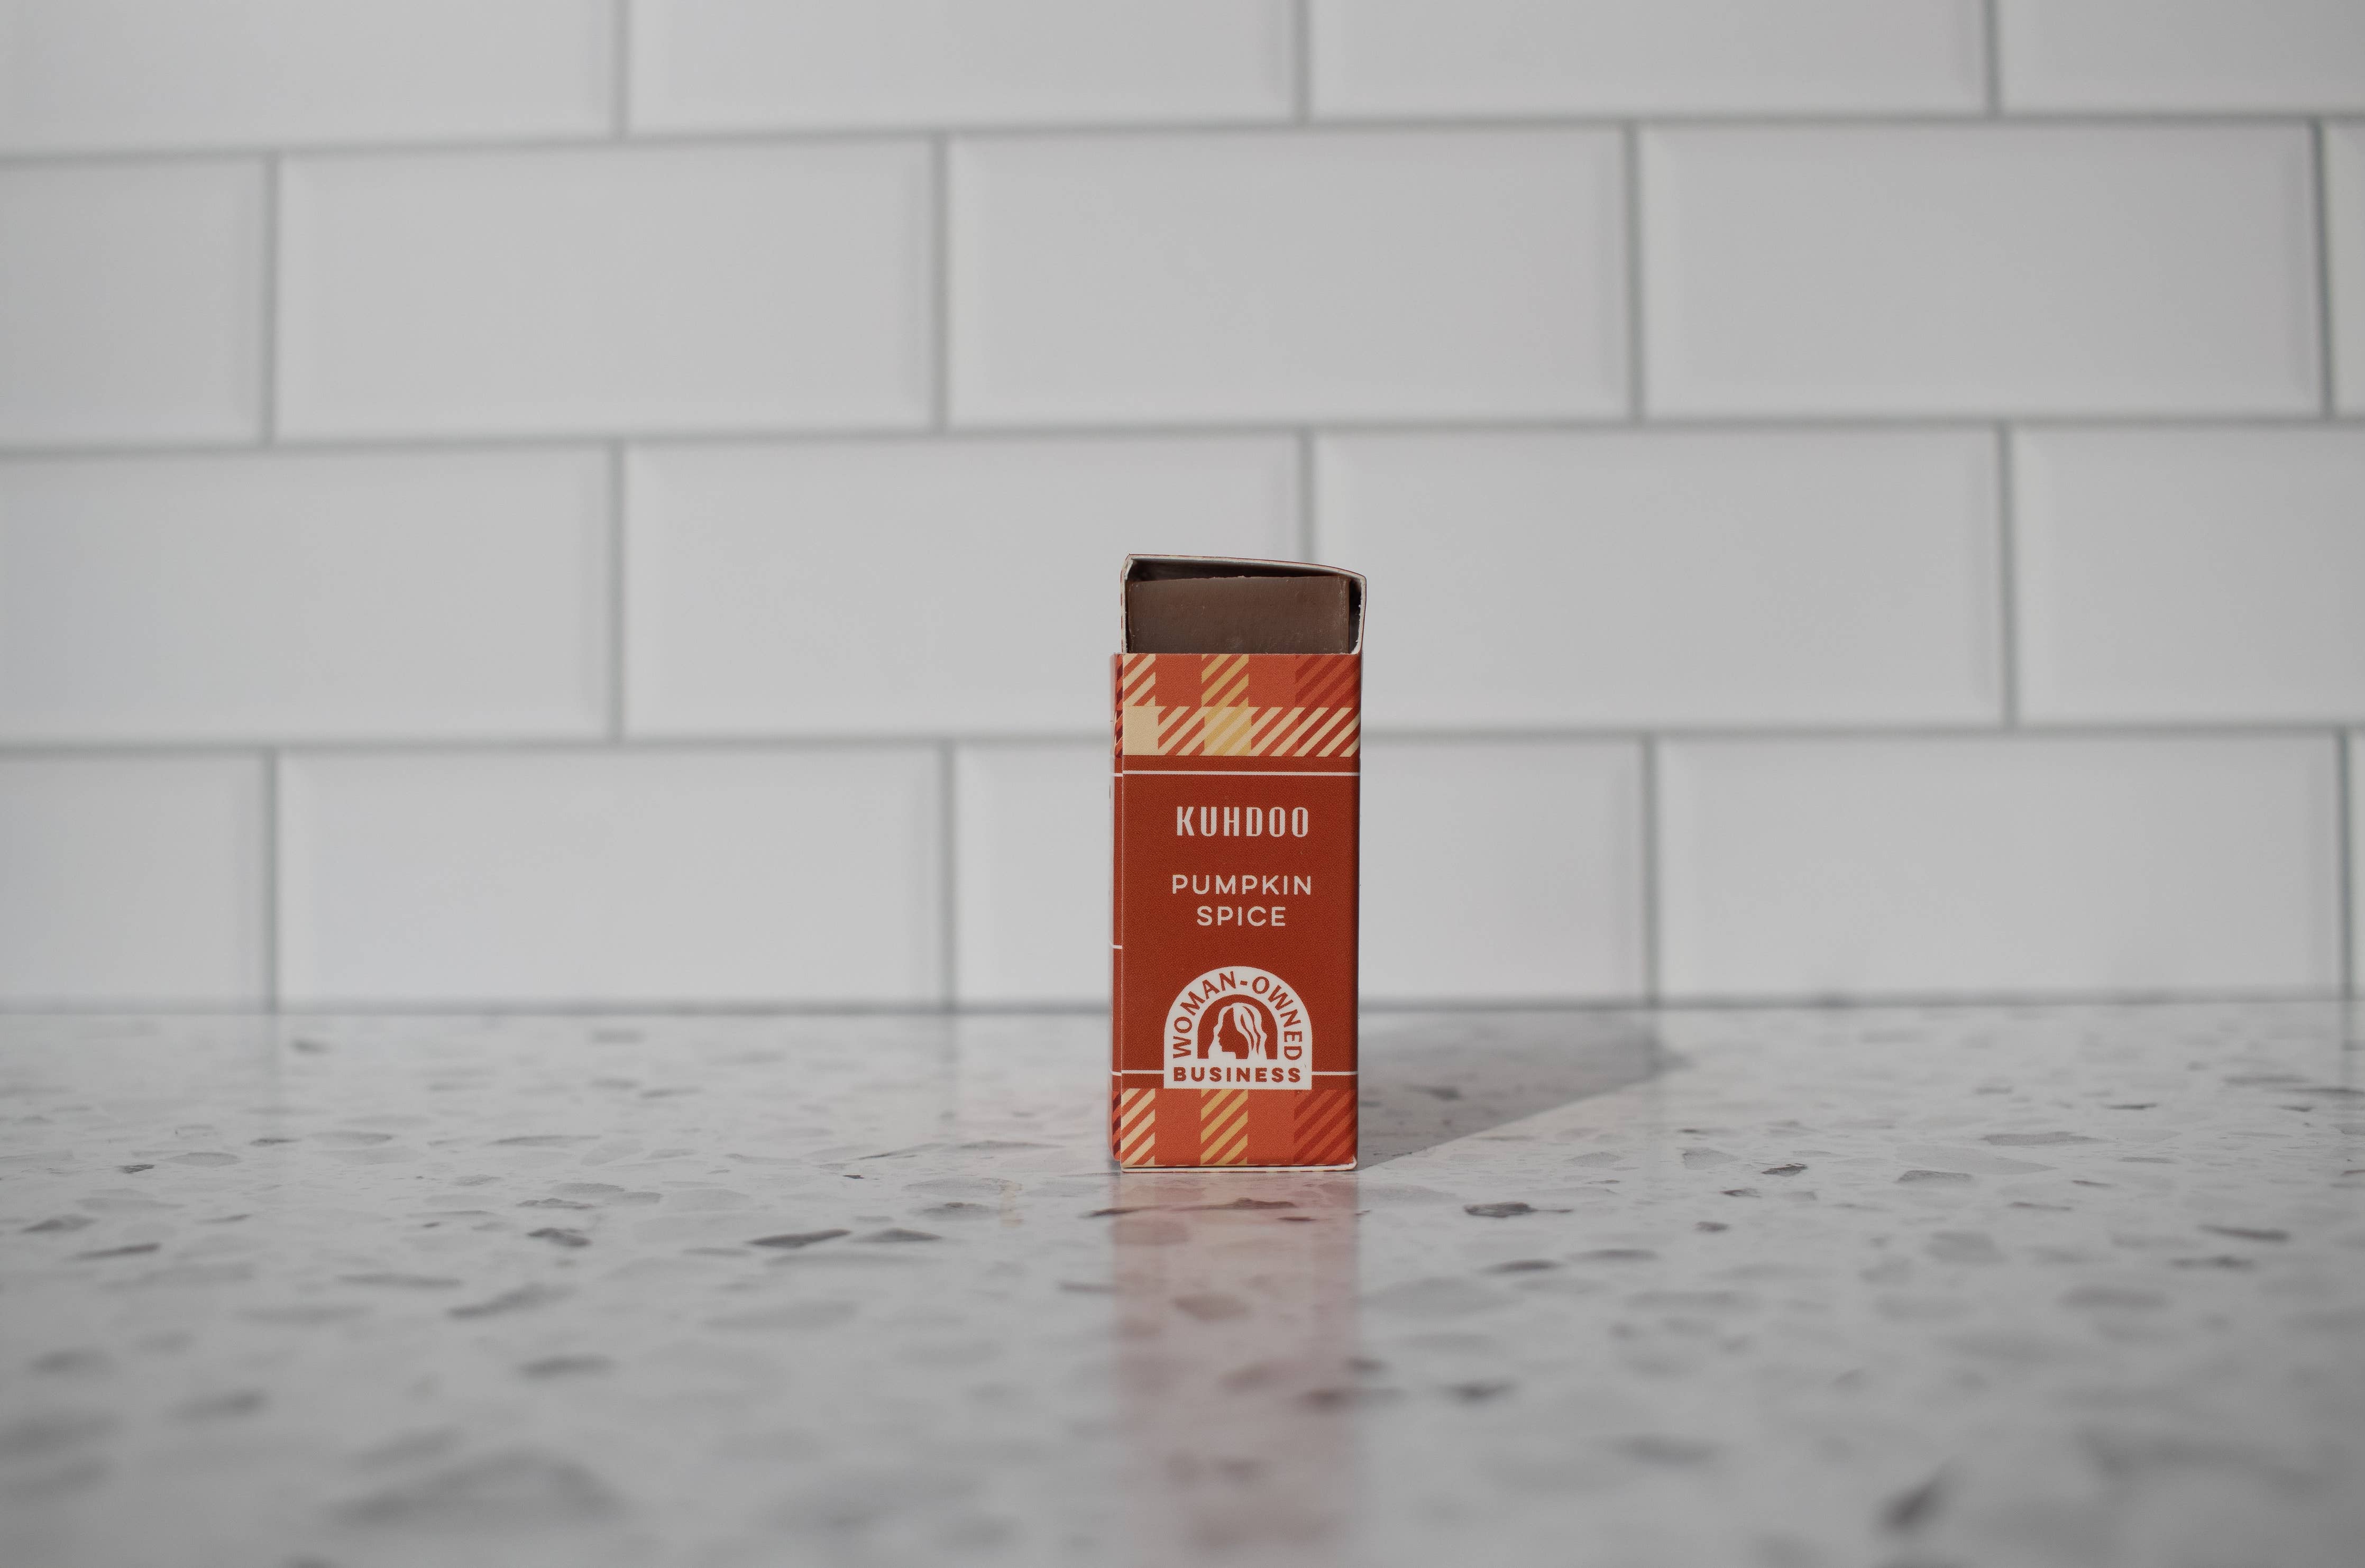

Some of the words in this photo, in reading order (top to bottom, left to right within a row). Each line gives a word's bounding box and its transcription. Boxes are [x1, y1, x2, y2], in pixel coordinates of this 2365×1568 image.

[1176, 806, 1309, 838] KUHDOO
[1172, 874, 1312, 895] PUMPKIN
[1196, 905, 1286, 927] SPICE
[1172, 970, 1303, 1061] WOMAN-OWNED
[1173, 1066, 1301, 1083] BUSINESS
